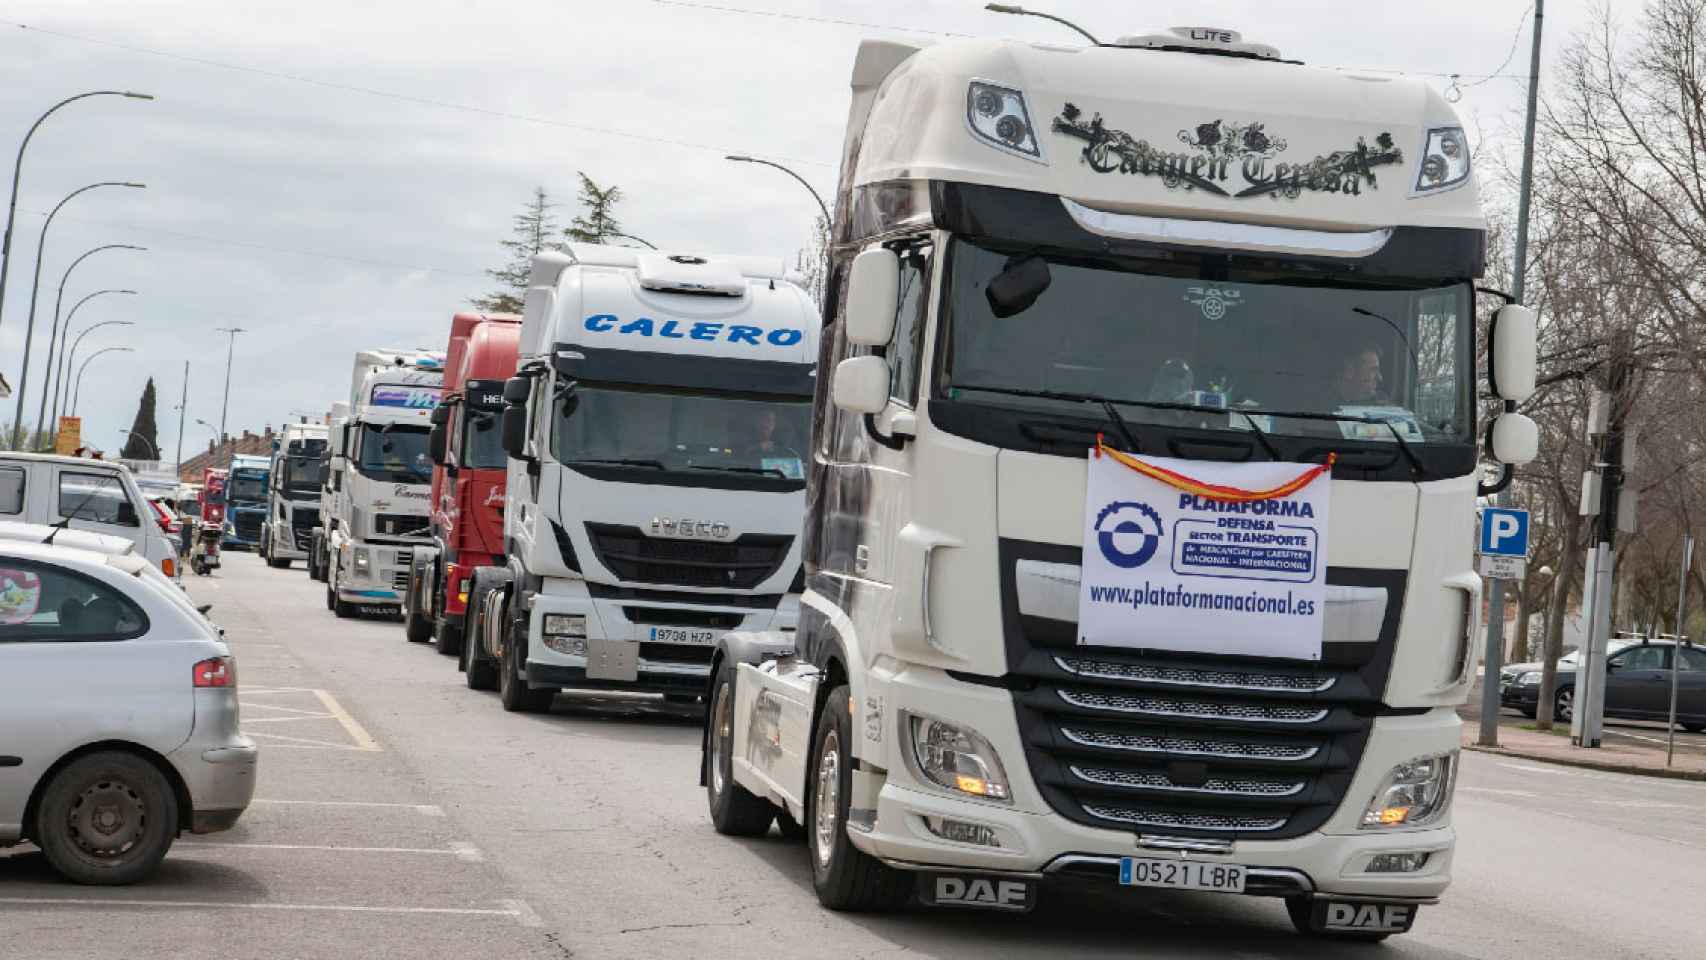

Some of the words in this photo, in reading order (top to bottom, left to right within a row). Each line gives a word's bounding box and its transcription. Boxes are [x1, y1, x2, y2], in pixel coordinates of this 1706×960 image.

[1190, 29, 1231, 43] LITE
[584, 314, 802, 346] CALERO
[1178, 493, 1314, 519] PLATAFORMA
[651, 517, 730, 538] IVECO
[1217, 517, 1275, 531] DEFENSA
[1490, 513, 1519, 549] P
[1189, 531, 1224, 541] SECTOR
[1226, 531, 1307, 546] TRANSPORTE
[1185, 554, 1230, 565] NACIONAL
[1240, 558, 1307, 570] INTERNACIONAL
[1090, 581, 1315, 616] www.plataformanacional.es
[1136, 862, 1189, 885] 0521
[1199, 865, 1241, 888] LBR
[936, 877, 1026, 906] DAF
[1326, 902, 1409, 931] DAF
